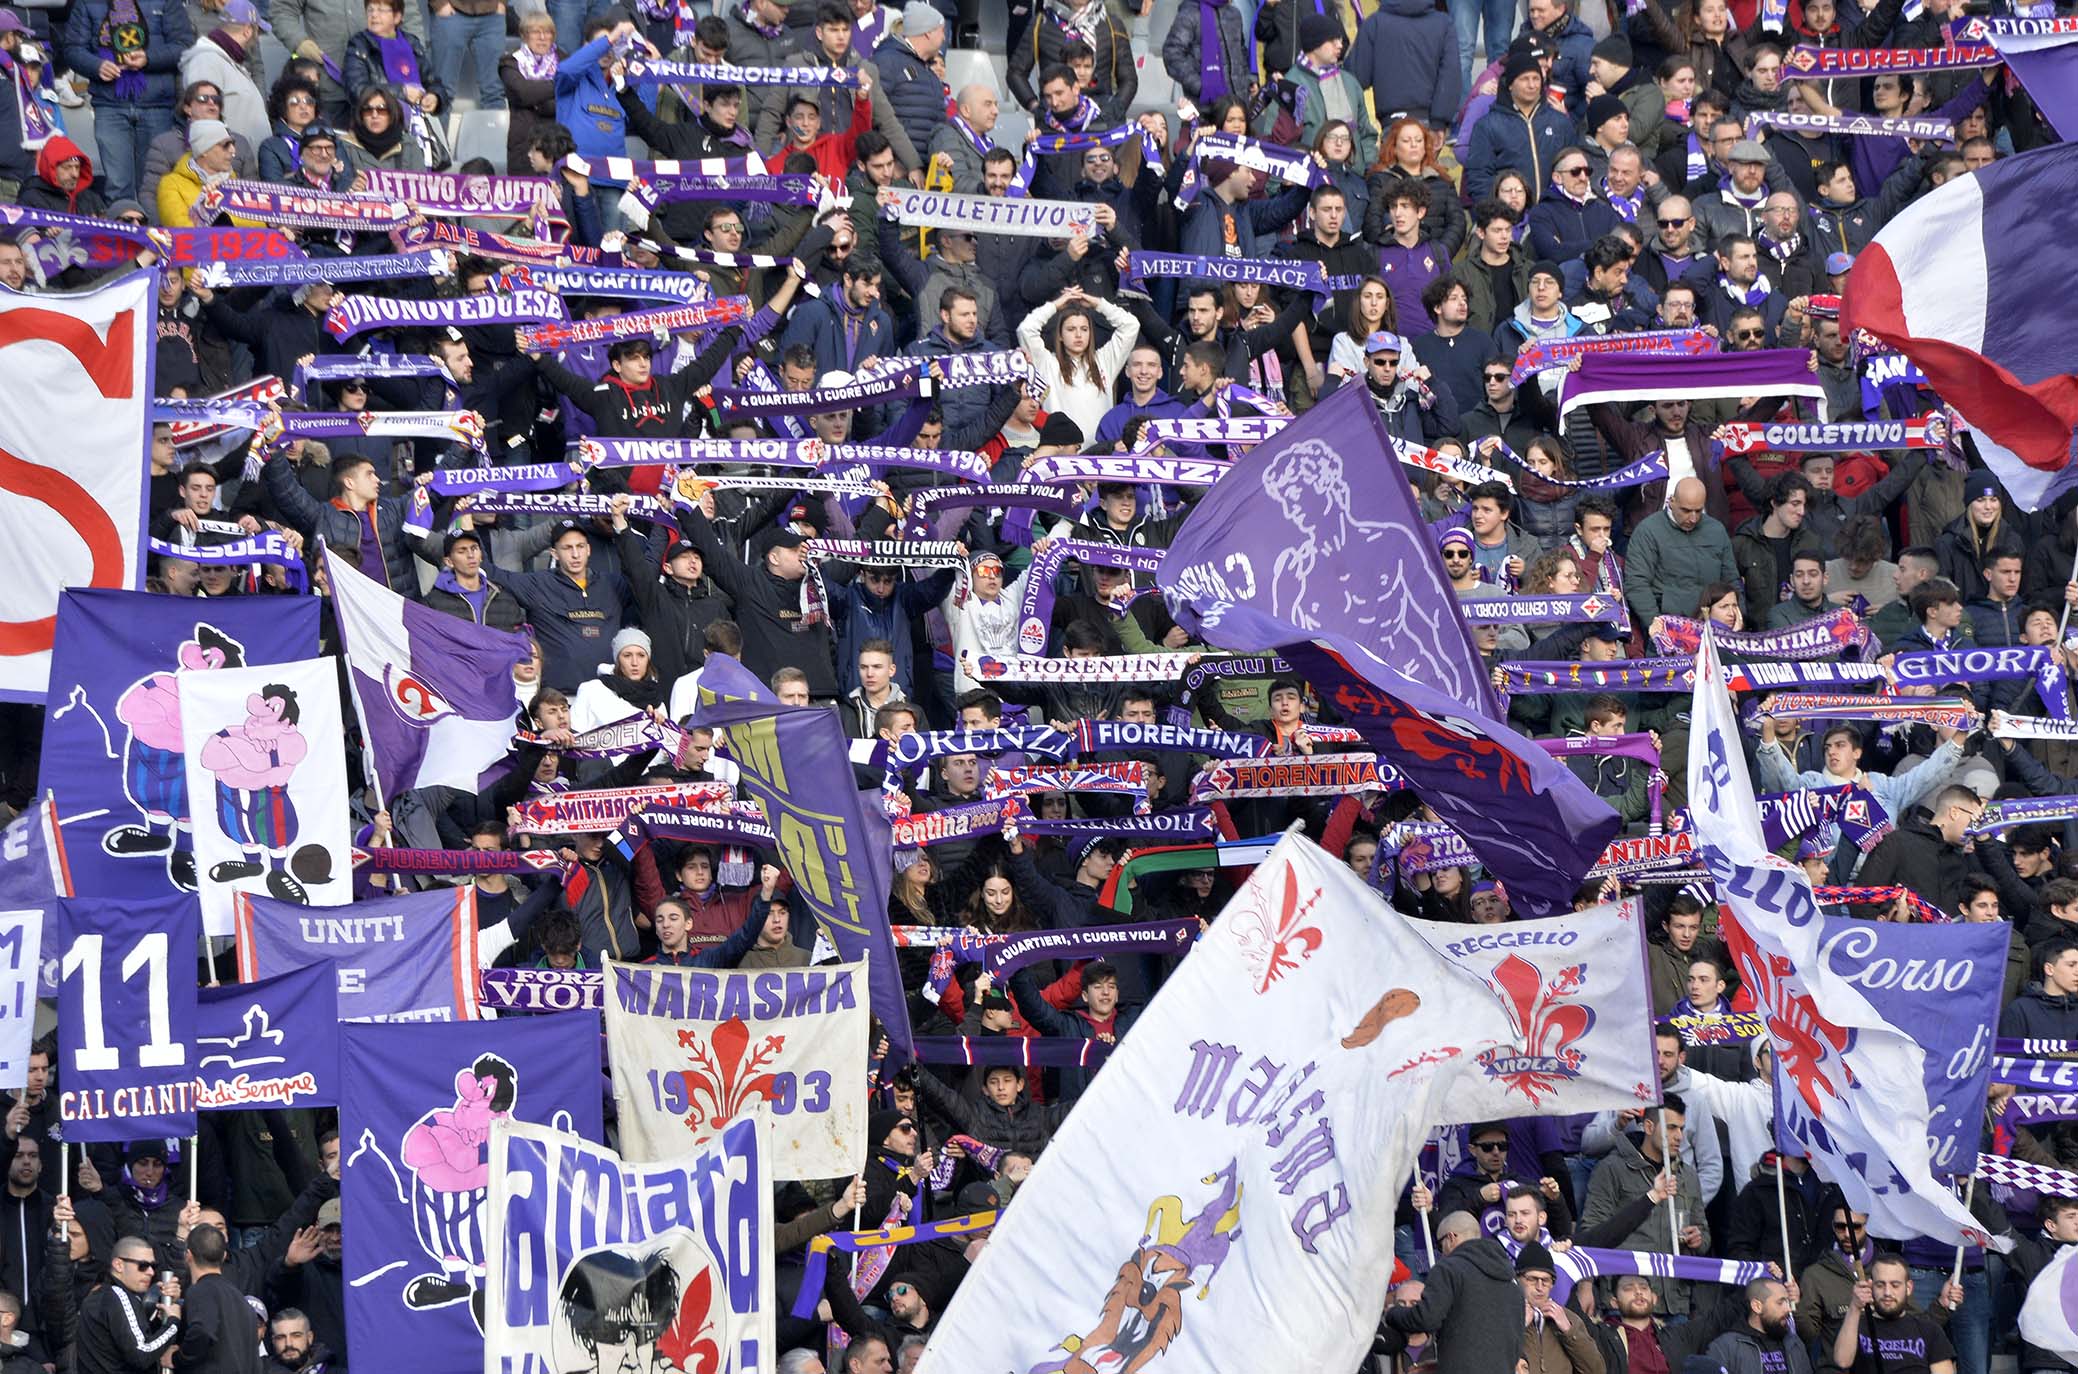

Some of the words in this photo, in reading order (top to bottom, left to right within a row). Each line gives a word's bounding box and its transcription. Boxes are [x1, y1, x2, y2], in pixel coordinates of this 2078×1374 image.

[1993, 16, 2078, 35] FIORE
[1819, 46, 1996, 72] FIORENTINA
[645, 61, 781, 83] FIORENTINA
[786, 67, 829, 83] ACF
[230, 191, 273, 211] ALE
[279, 195, 394, 219] FIORENTIN
[905, 195, 1066, 226] COLLETTIVO
[209, 231, 289, 261] 1926
[433, 221, 481, 248] ALE
[232, 264, 281, 283] ACF
[283, 257, 428, 282] FIORENTINA
[1142, 259, 1238, 278] MEETNG
[1243, 265, 1318, 288] PLACE
[589, 273, 696, 298] CAPITANO
[1551, 336, 1674, 359] FIORENTINA
[740, 395, 748, 407] 4
[750, 392, 814, 407] QUARTIERI,
[817, 390, 824, 402] 1
[825, 386, 862, 402] CUORE
[863, 380, 897, 394] VIOLA
[289, 416, 351, 431] Fiorentina
[1766, 423, 1902, 446] COLLETTIVO
[612, 440, 651, 461] VINCI
[689, 440, 732, 459] PER
[740, 440, 788, 460] NOI
[445, 462, 558, 485] FIORENTINA
[987, 484, 1029, 496] CUORE
[1030, 484, 1064, 499] VIOLA
[874, 540, 959, 556] TOTTENHA
[1474, 603, 1508, 617] COORD.
[1511, 601, 1548, 616] CENTRO
[1553, 601, 1572, 615] ASS.
[1018, 655, 1180, 674] FIORENTINA
[1873, 710, 1965, 728] SUPPORT
[1098, 723, 1254, 758] FIORENTINA
[1237, 761, 1378, 789] FIORENTINA
[639, 811, 680, 825] VIOLA
[681, 814, 724, 829] CUORE
[972, 811, 998, 828] 2000
[374, 850, 519, 870] FIORENTINA
[1596, 833, 1694, 865] ENTINA
[299, 914, 405, 945] UNITI
[1002, 933, 1071, 961] QUARTIERI,
[1083, 930, 1128, 943] CUORE
[1129, 929, 1167, 942] VIOLA
[1446, 931, 1578, 957] REGGELLO
[1821, 926, 1976, 992] Corso
[62, 931, 186, 1071] 11
[616, 966, 856, 1022] MARASMA
[1946, 1023, 1991, 1080] di
[1494, 1055, 1559, 1074] VIOLA
[232, 1076, 315, 1104] Sempre
[2013, 1094, 2078, 1119] PAZ
